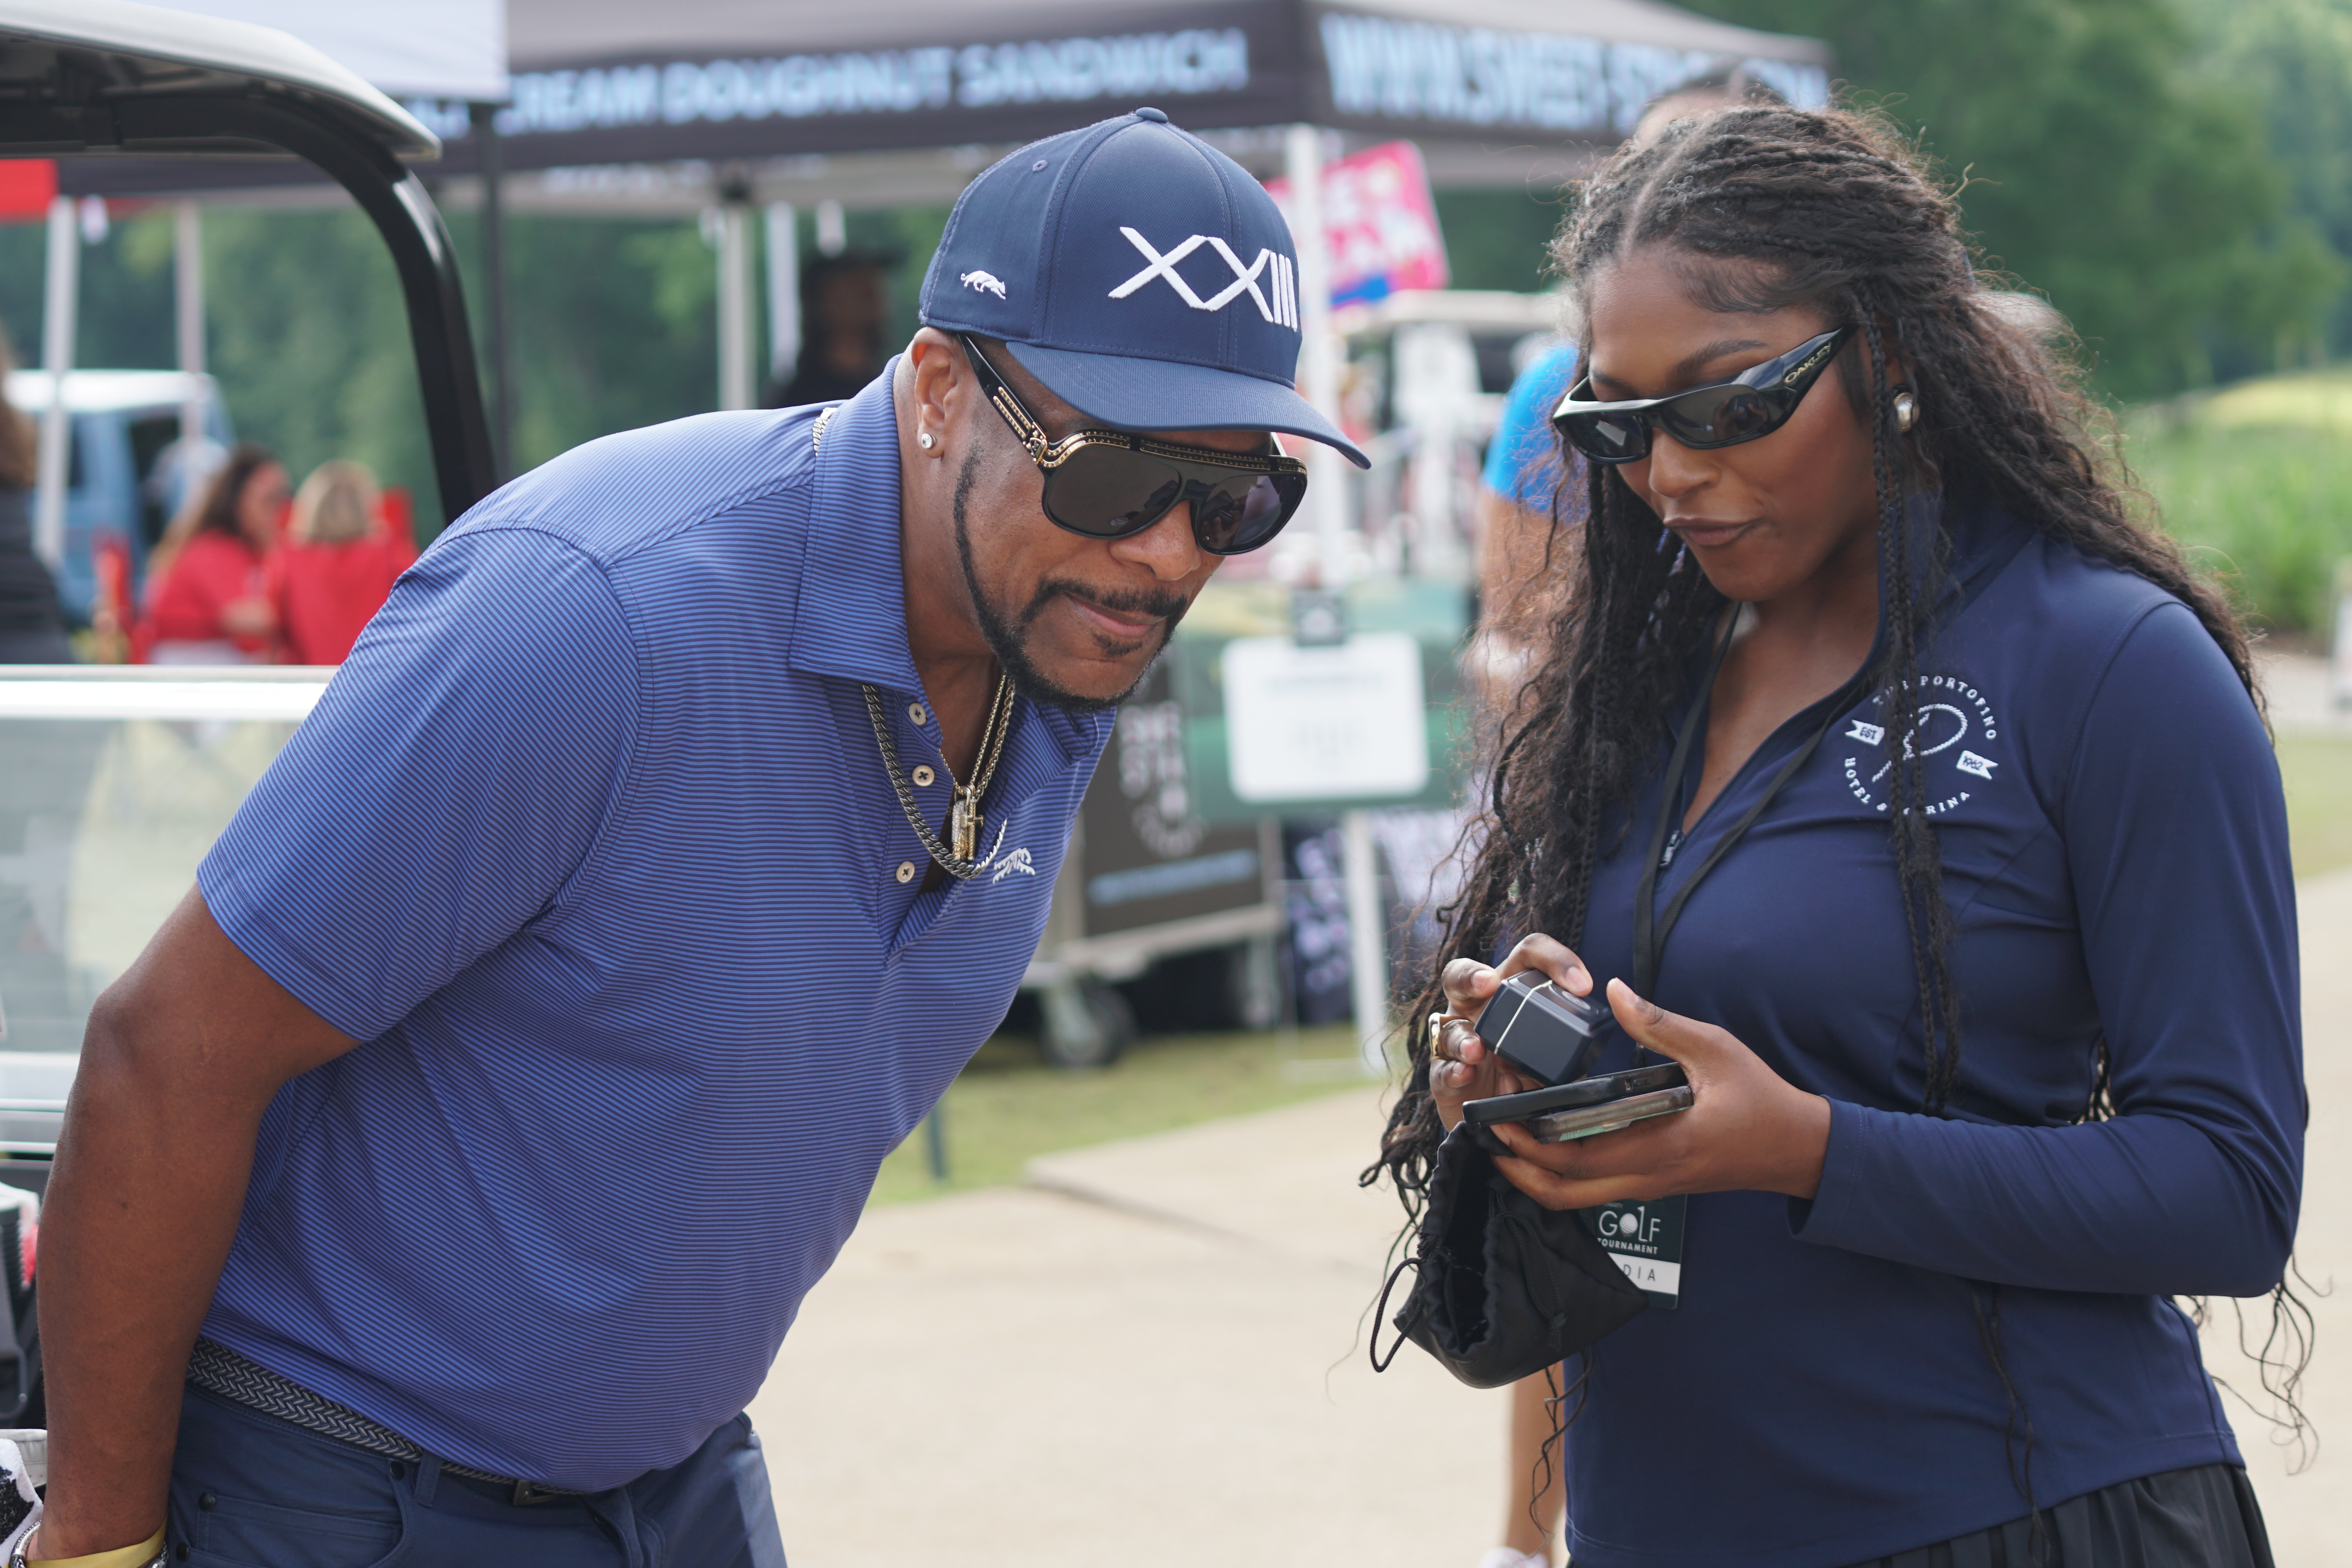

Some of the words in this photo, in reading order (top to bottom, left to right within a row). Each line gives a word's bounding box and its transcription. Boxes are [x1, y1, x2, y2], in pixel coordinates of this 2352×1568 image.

[662, 47, 954, 125] DOUGHNUT
[955, 27, 1248, 108] SANDWICH
[1108, 226, 1298, 332] XXIII
[1784, 341, 1831, 383] OAKLEY
[1920, 675, 1997, 740] PORTOFINO
[1860, 727, 1877, 740] EST
[1844, 757, 1871, 804] HOTEL
[1599, 1205, 1661, 1242] GOLF
